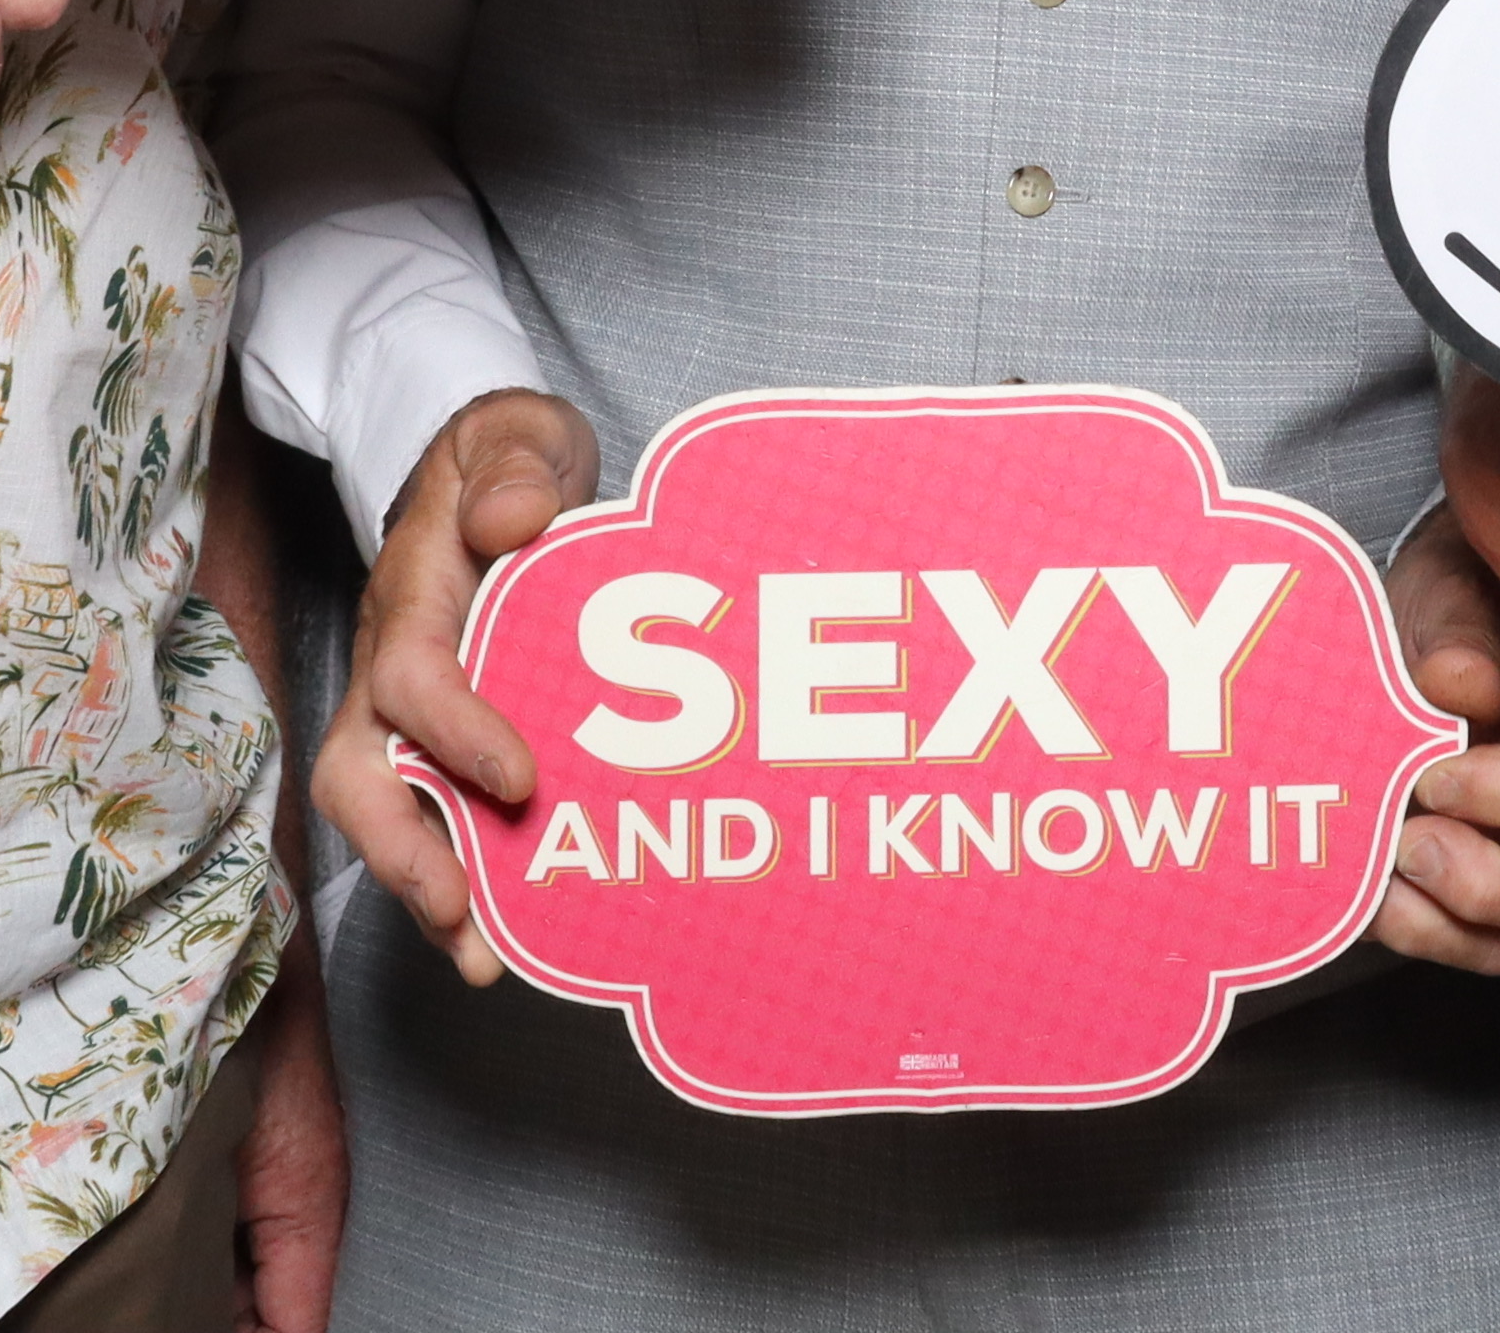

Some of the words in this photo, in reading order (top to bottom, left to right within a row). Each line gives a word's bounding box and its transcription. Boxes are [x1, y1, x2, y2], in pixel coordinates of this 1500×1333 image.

[571, 562, 1300, 774] SEXY
[524, 798, 781, 885] AND
[808, 796, 836, 879] I
[868, 787, 1227, 879] KNOW
[1249, 783, 1348, 869] IT
